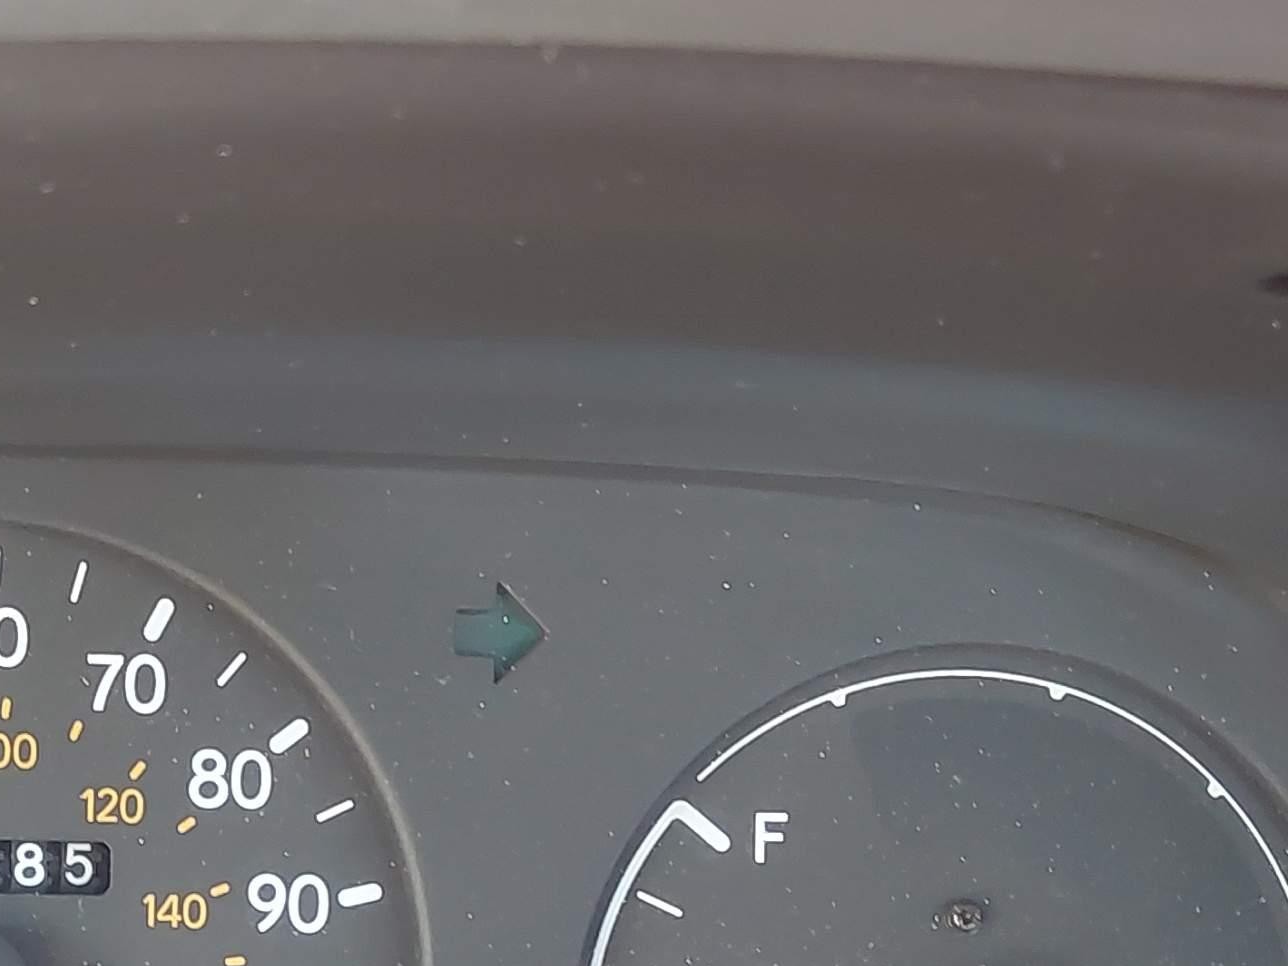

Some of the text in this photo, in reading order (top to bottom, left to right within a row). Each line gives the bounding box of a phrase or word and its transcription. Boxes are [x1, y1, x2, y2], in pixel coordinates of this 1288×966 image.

[86, 653, 166, 715] 70
[81, 786, 145, 825] 120
[188, 748, 272, 810] 80
[754, 812, 789, 864] F
[144, 893, 208, 929] 140
[247, 873, 330, 934] 90
